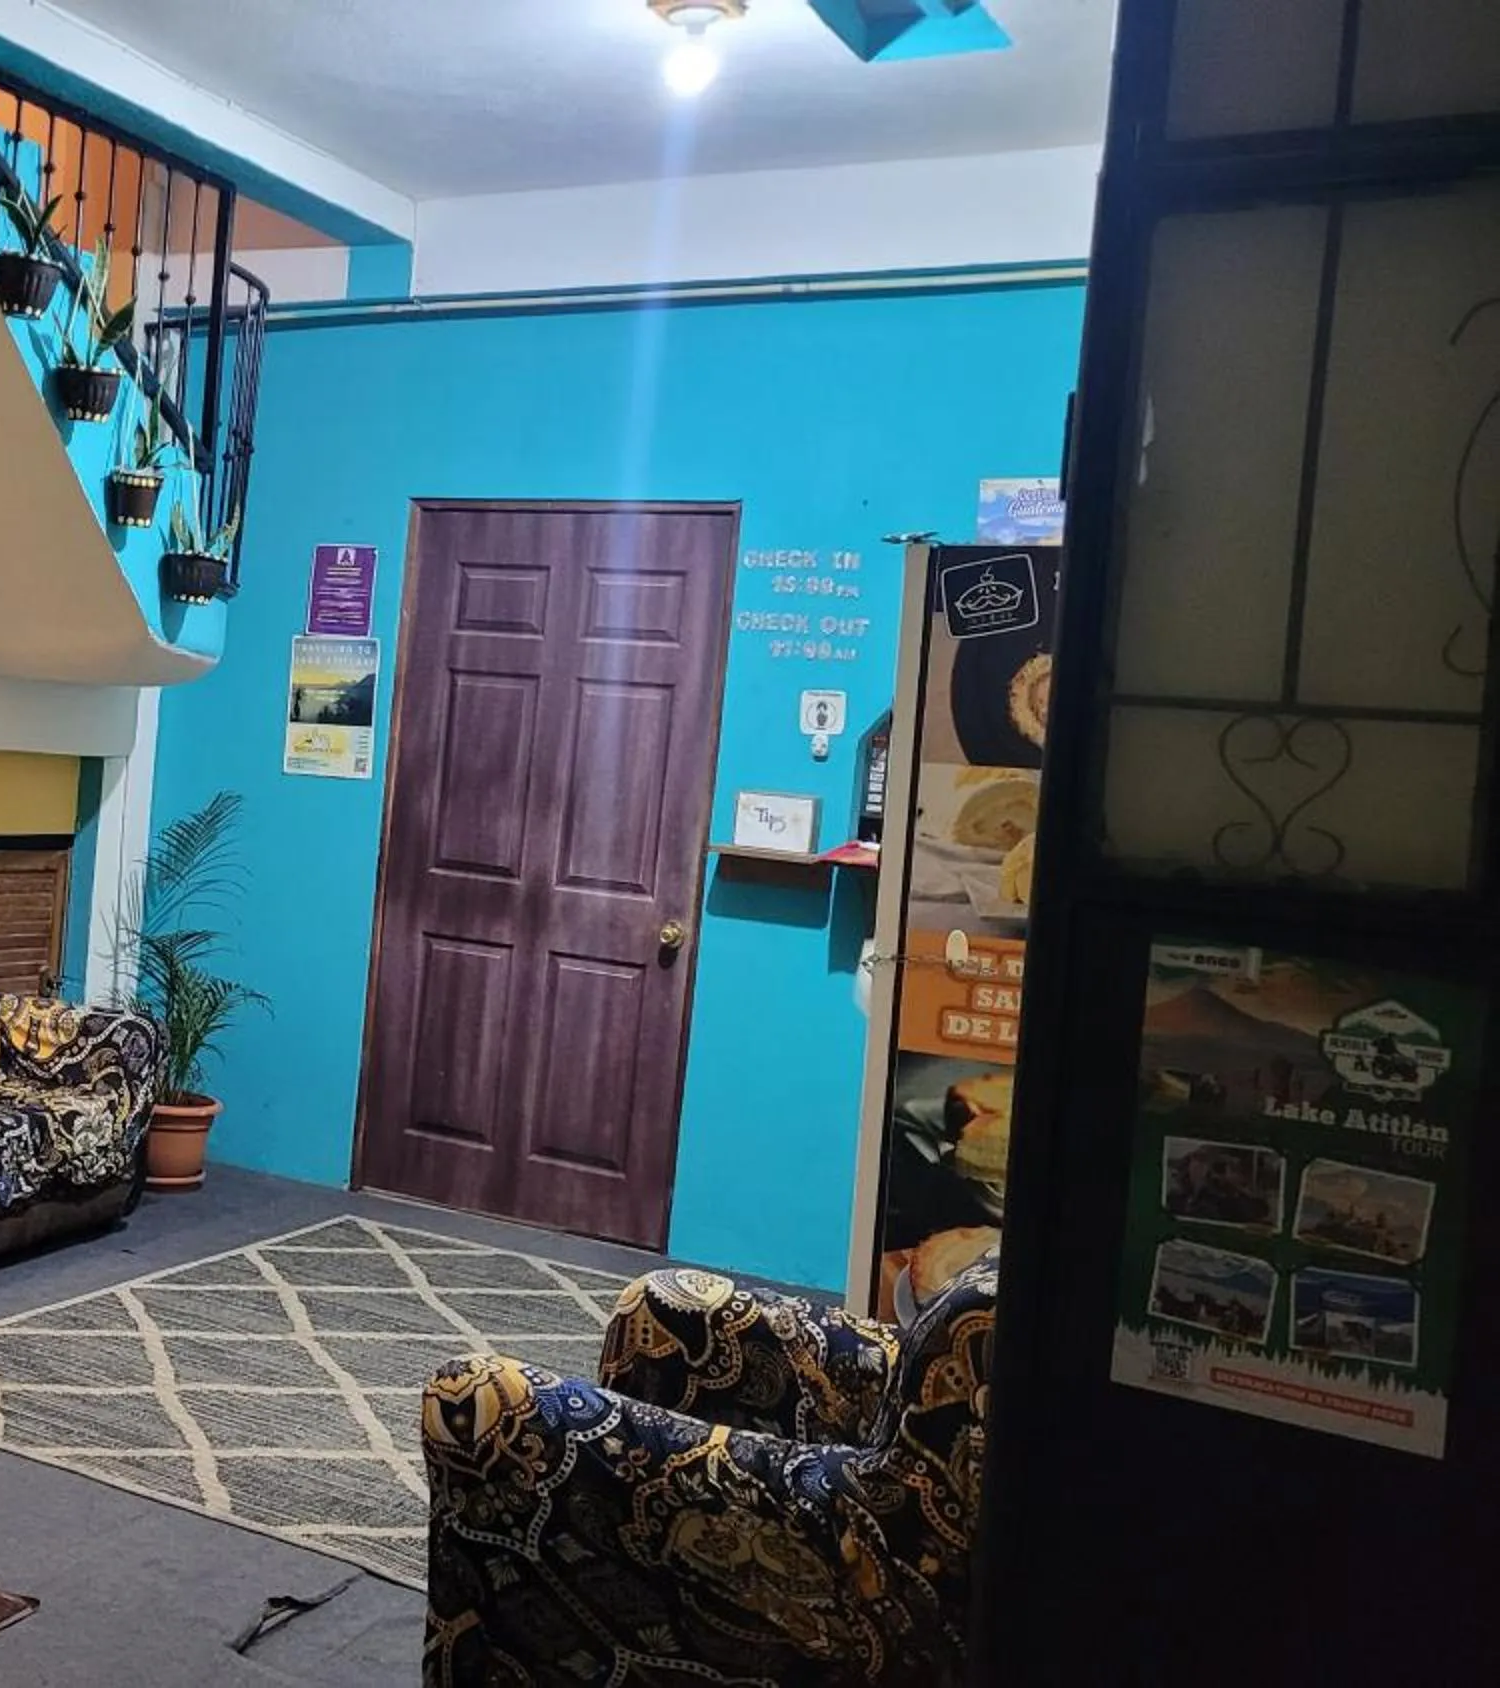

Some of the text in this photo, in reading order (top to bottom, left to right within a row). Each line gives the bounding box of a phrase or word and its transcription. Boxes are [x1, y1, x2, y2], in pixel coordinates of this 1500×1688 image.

[743, 548, 861, 571] CHECK IN
[736, 610, 871, 638] CHECK OUT
[977, 986, 1022, 1011] SA
[947, 1014, 992, 1039] DE
[1263, 1095, 1338, 1128] Lake
[1389, 1137, 1448, 1163] TOUR
